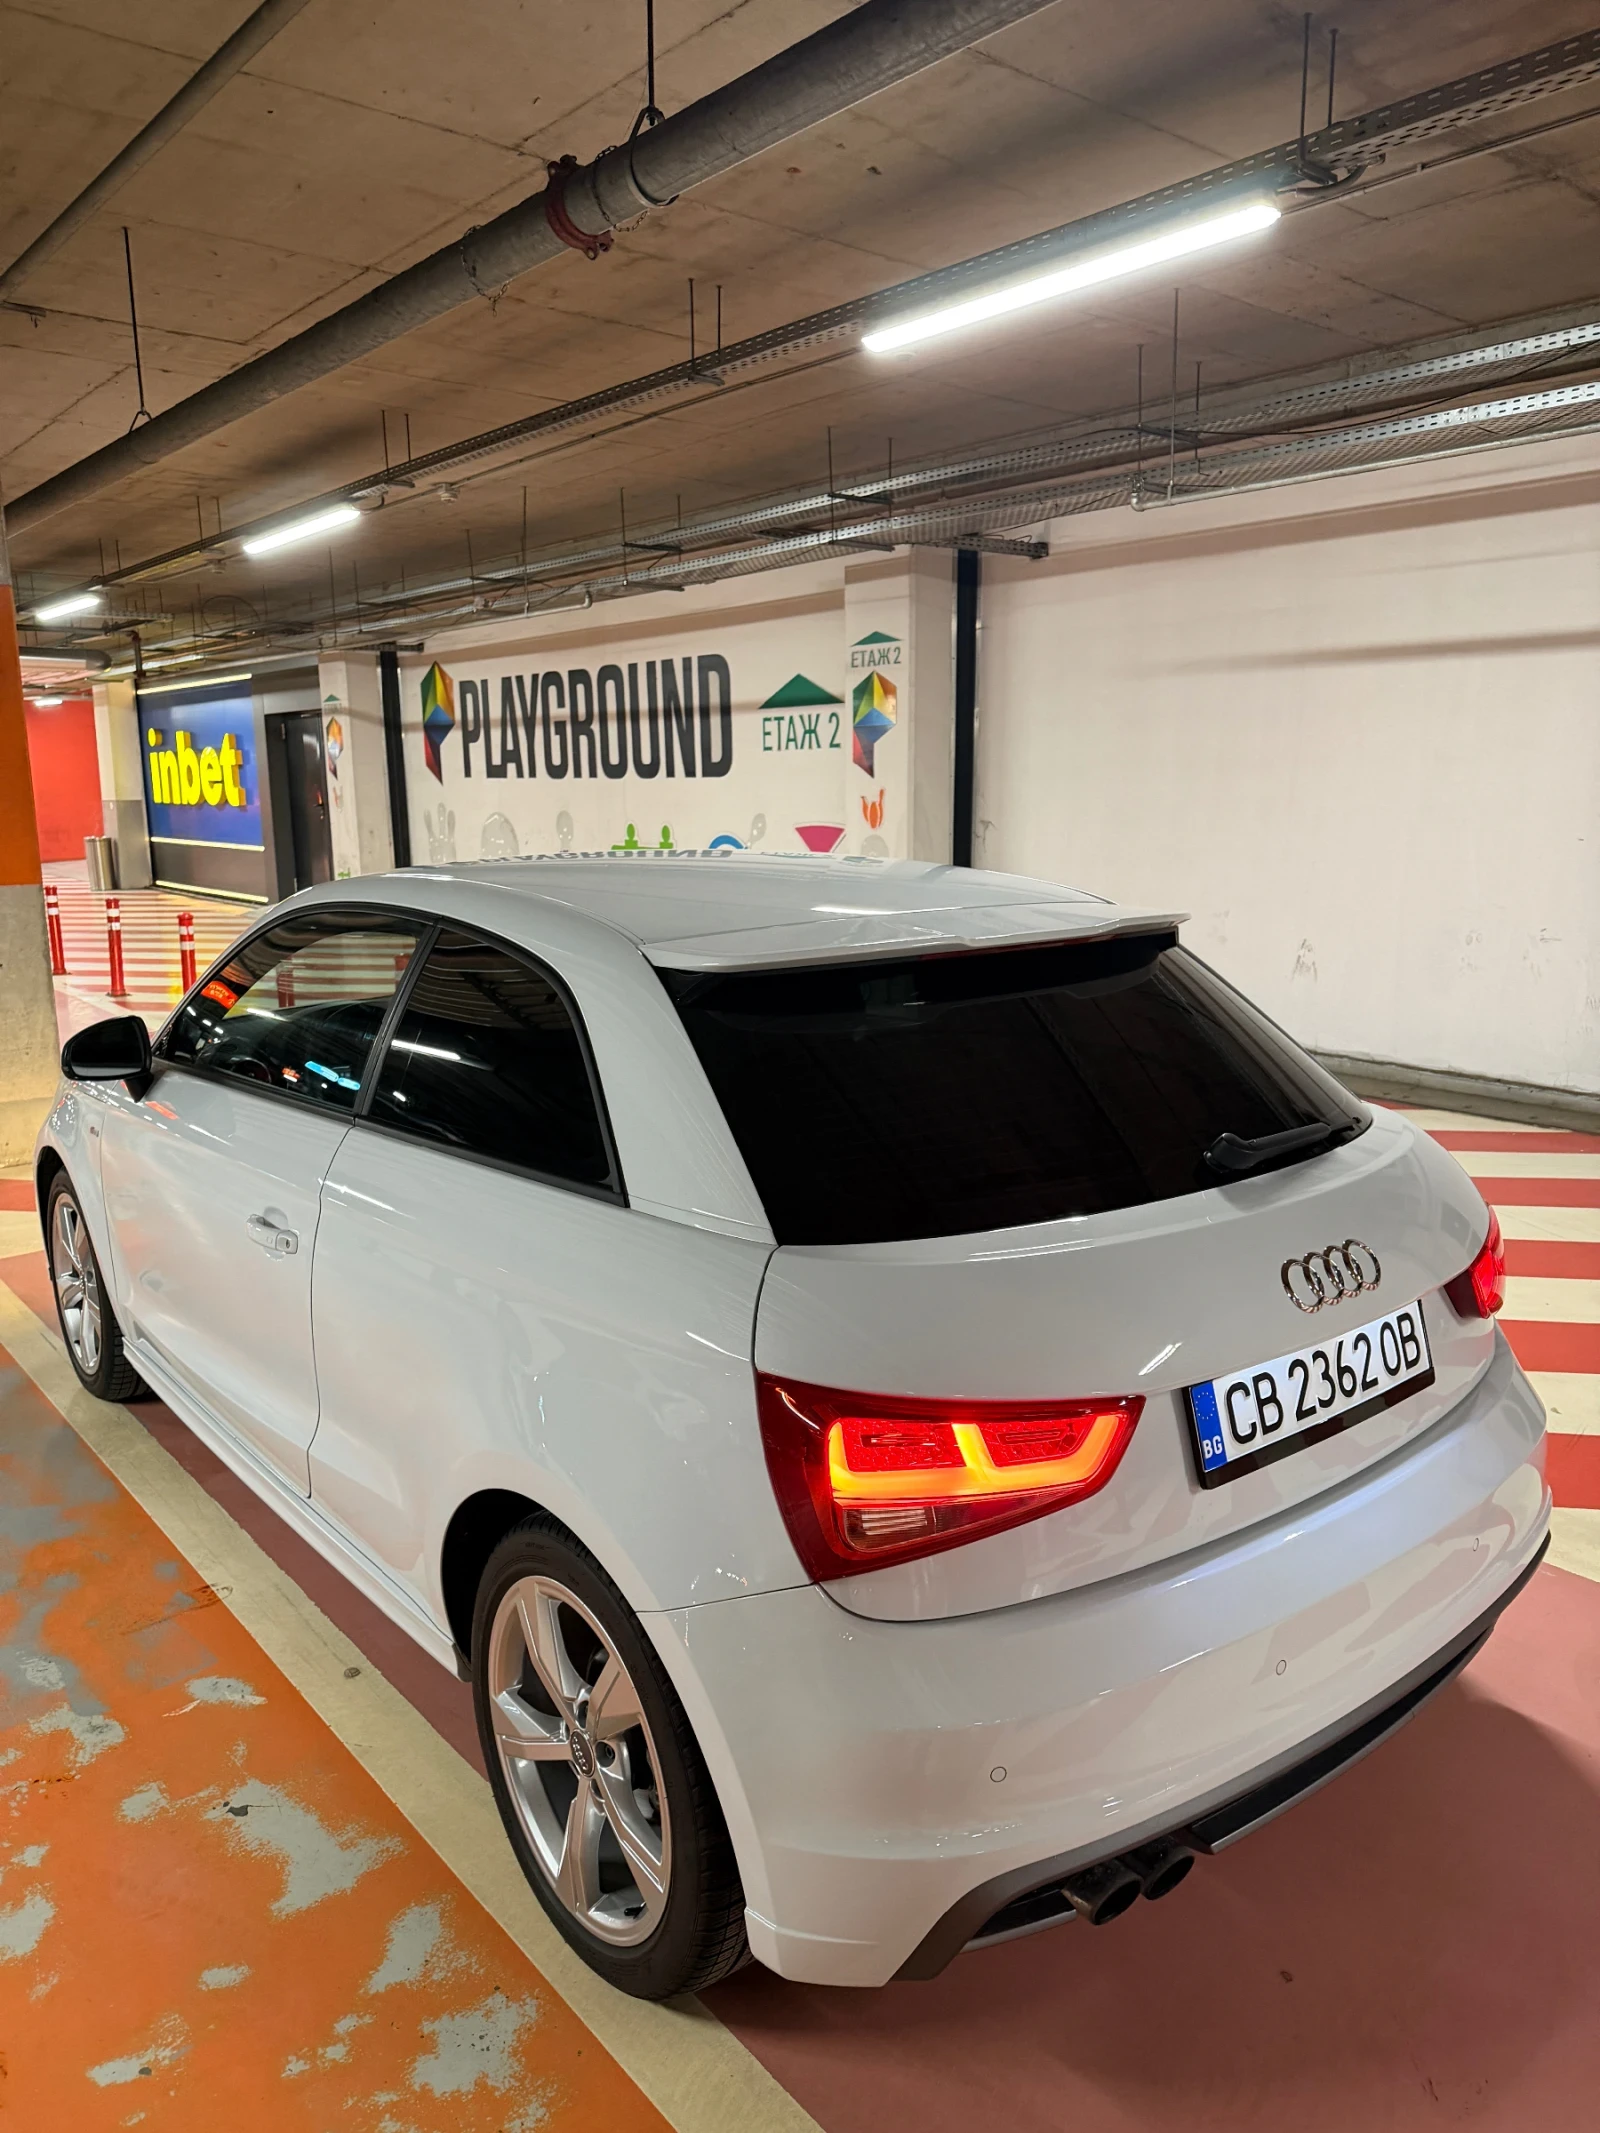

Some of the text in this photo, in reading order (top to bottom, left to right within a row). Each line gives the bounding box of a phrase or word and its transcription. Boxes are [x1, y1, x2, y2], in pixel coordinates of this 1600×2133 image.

[850, 646, 902, 668] ЕТАЖ 2
[459, 654, 733, 780] PLAYGROUND
[762, 712, 841, 752] ЕТАЖ 2
[148, 728, 247, 808] inbet
[1226, 1371, 1284, 1445] CB
[1288, 1332, 1379, 1422] 2362
[1202, 1435, 1223, 1459] BG
